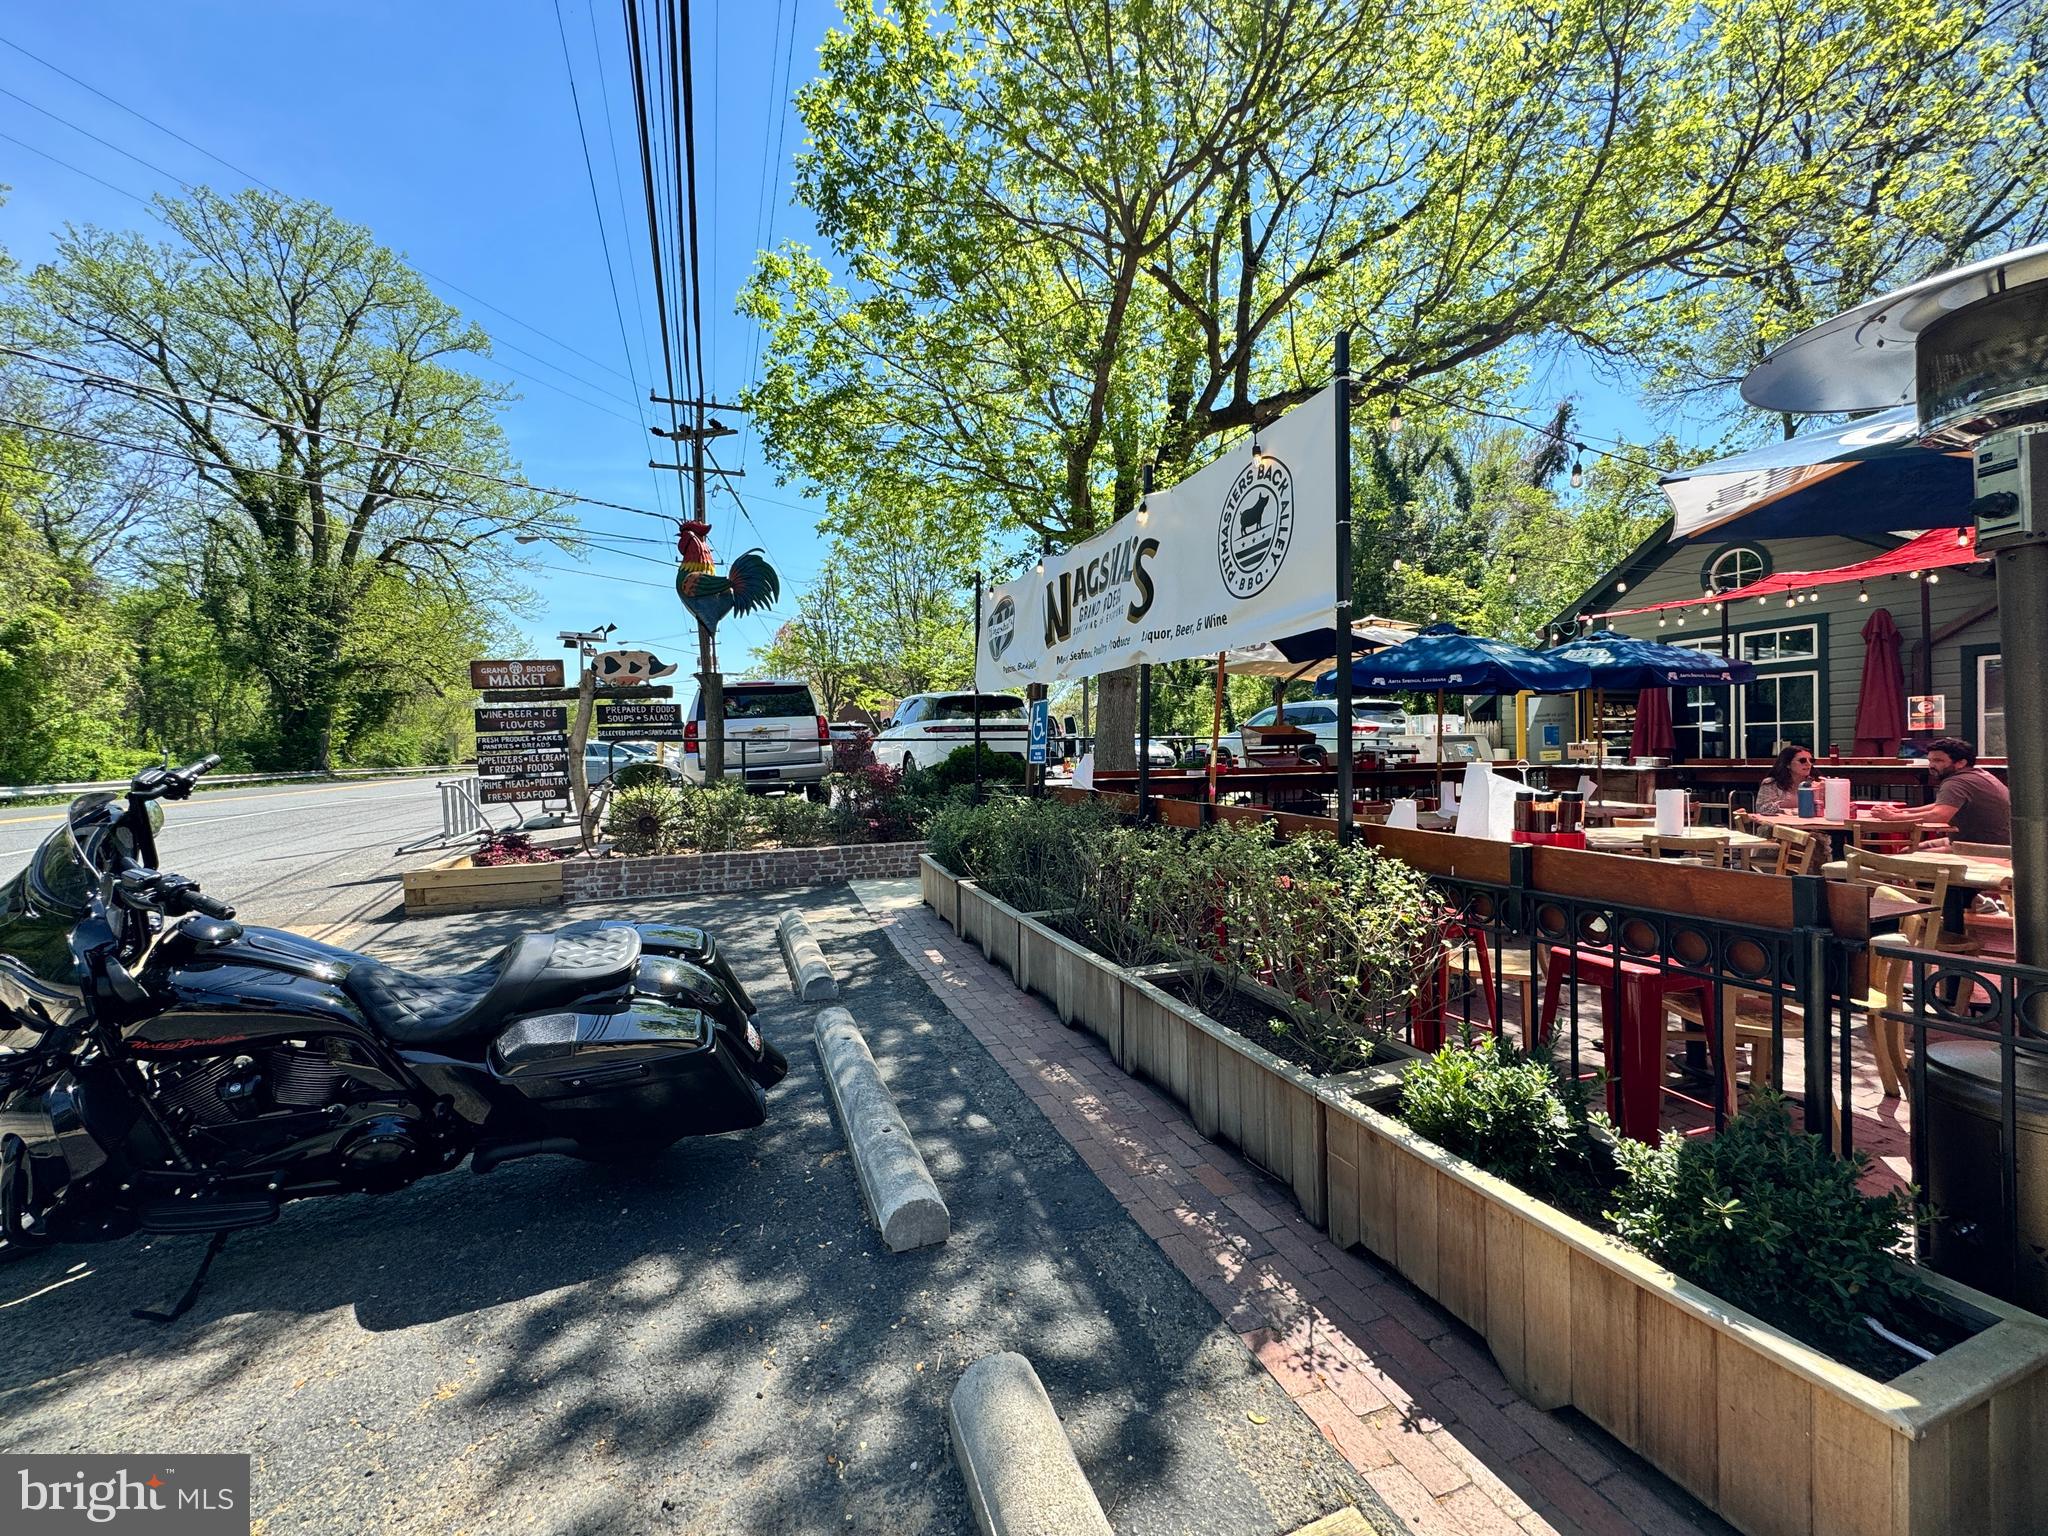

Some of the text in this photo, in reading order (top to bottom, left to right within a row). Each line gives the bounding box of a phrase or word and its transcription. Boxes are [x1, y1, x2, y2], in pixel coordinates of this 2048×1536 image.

[1220, 464, 1290, 584] PITMASTERS BACK ALLEY
[1239, 572, 1264, 590] BBQ
[1175, 624, 1195, 638] Beer,
[1196, 619, 1202, 631] &
[1205, 613, 1228, 629] Wine
[526, 665, 557, 673] BODEGA
[489, 673, 546, 687] MARKET
[480, 709, 558, 719] WINE BEER ICE
[605, 705, 676, 714] PREPARED FOODS
[607, 714, 675, 722] SOUPS SALADS
[500, 720, 546, 729] FLOWERS
[1433, 723, 1452, 733] IE
[478, 755, 523, 765] APPETIZERS
[541, 753, 566, 762] CREAM
[489, 763, 554, 774] FROZEN FOODS
[480, 777, 569, 790] PRIME MEATS POULTRY
[487, 789, 556, 801] FRESH SEAFOOD
